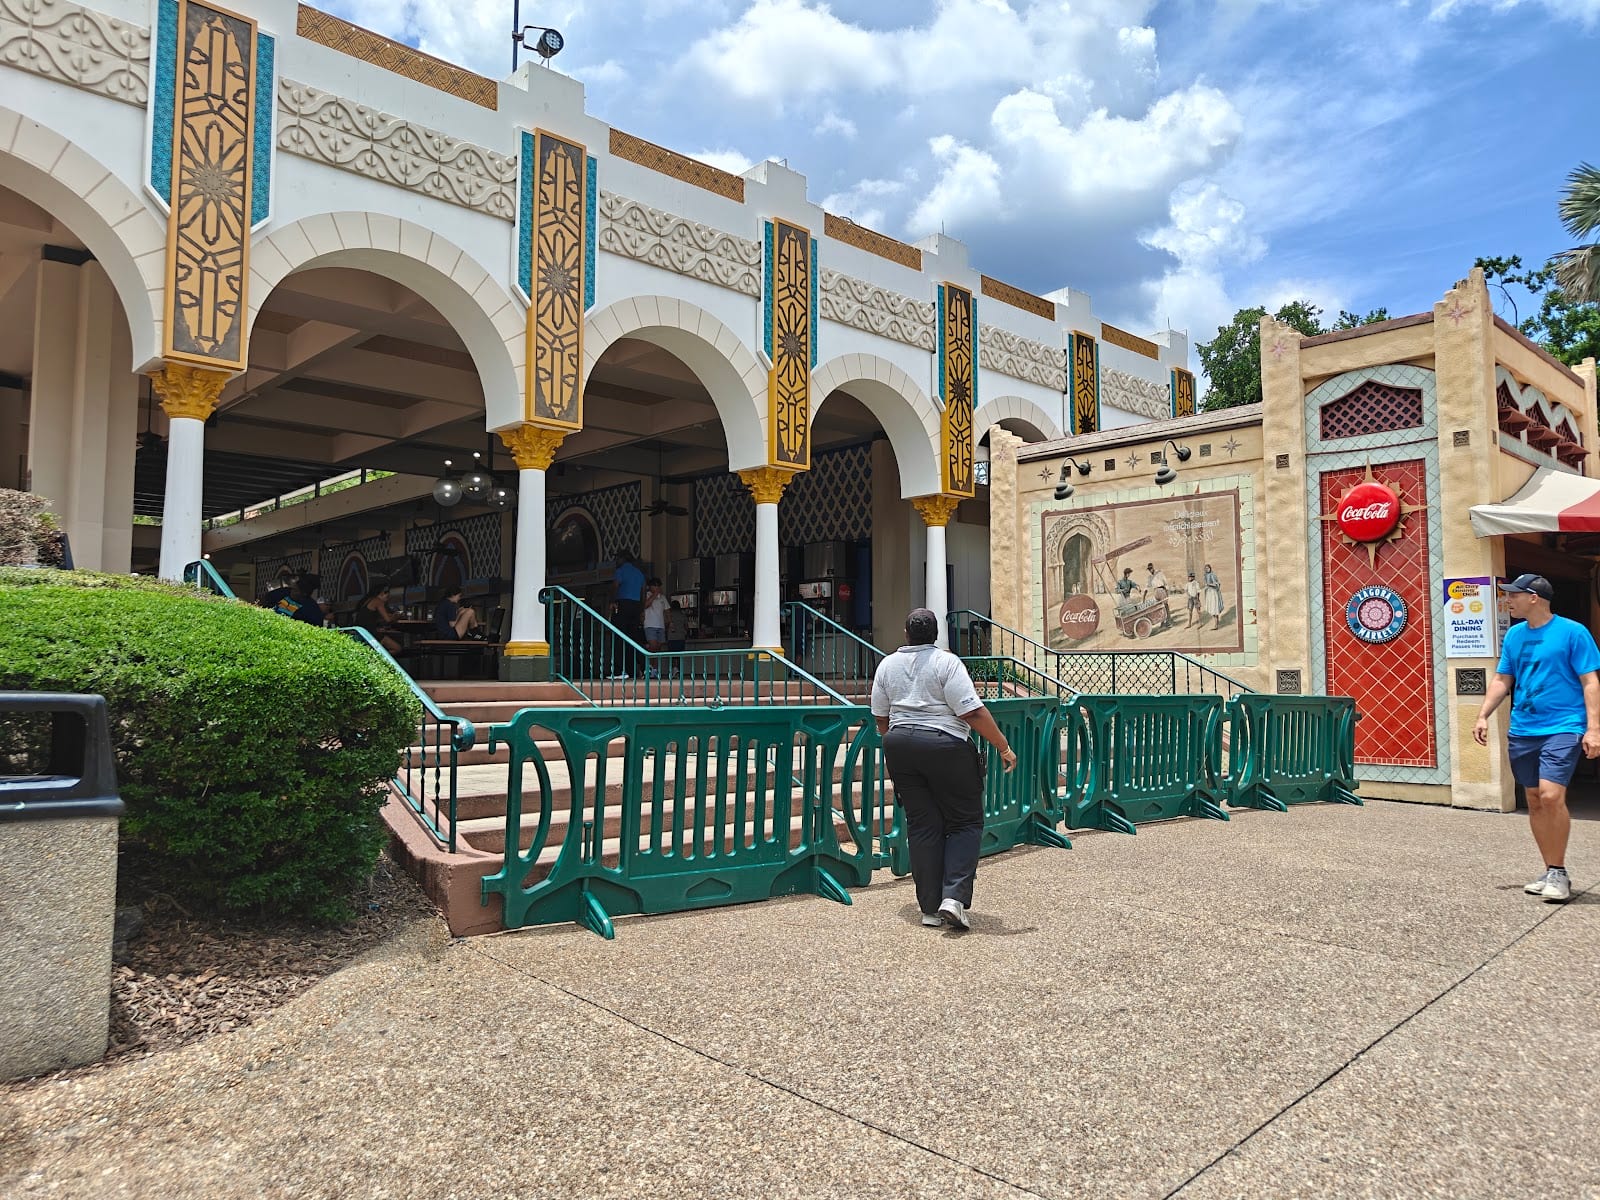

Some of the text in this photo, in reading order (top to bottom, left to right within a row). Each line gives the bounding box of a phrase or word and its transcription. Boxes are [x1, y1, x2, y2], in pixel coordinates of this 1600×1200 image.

[1341, 502, 1392, 522] Coca-Cola
[1357, 587, 1392, 601] ZAGORA
[1062, 608, 1098, 624] Coca-Cola
[1357, 627, 1393, 640] MARKET
